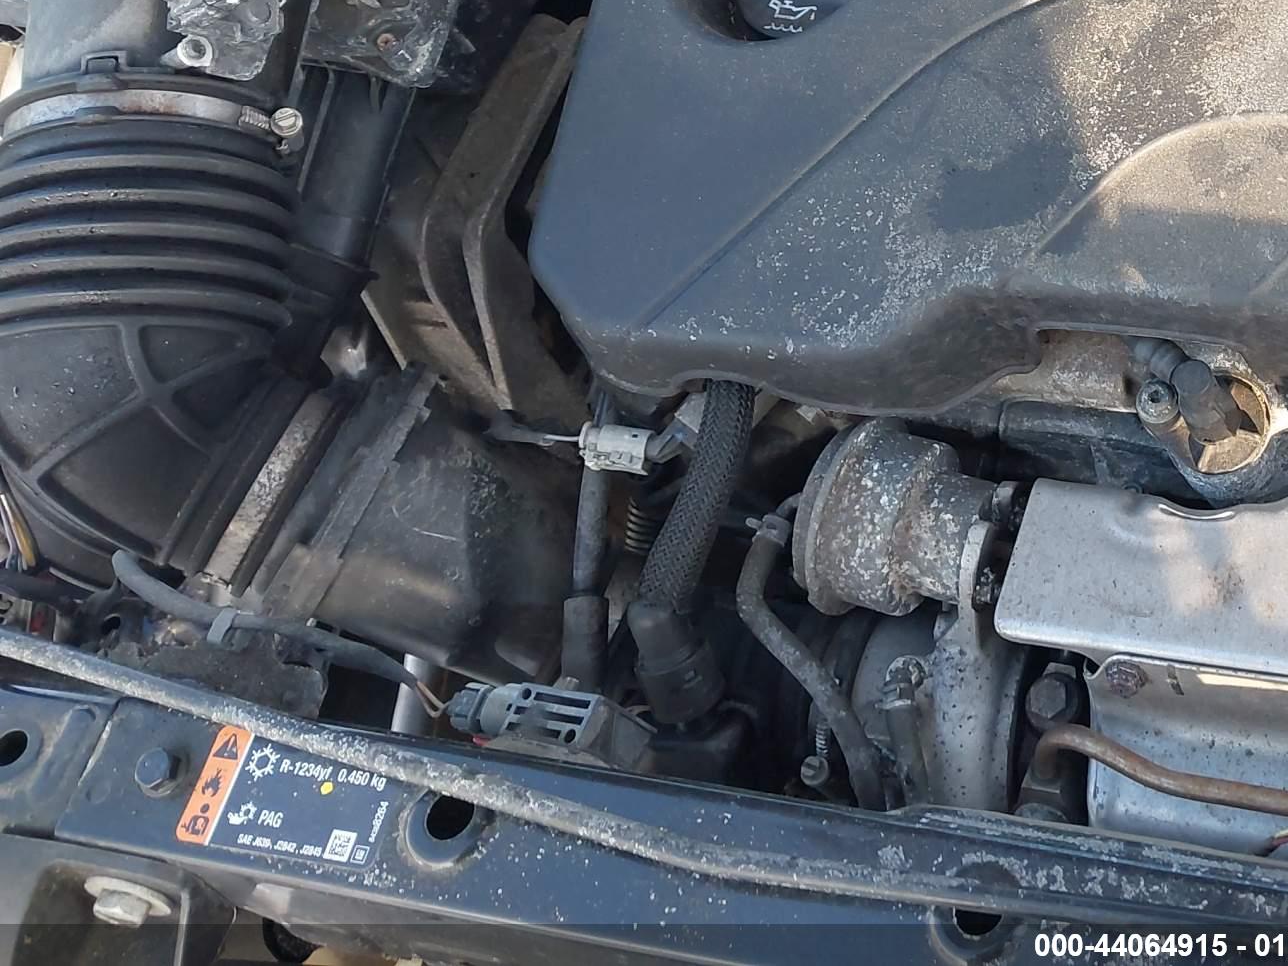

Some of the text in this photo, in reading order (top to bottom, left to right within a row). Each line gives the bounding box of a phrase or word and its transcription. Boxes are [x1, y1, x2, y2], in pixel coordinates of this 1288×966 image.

[279, 759, 387, 791] R-1234yf 0.450 kg
[257, 809, 284, 828] PAG
[237, 834, 252, 846] SAE
